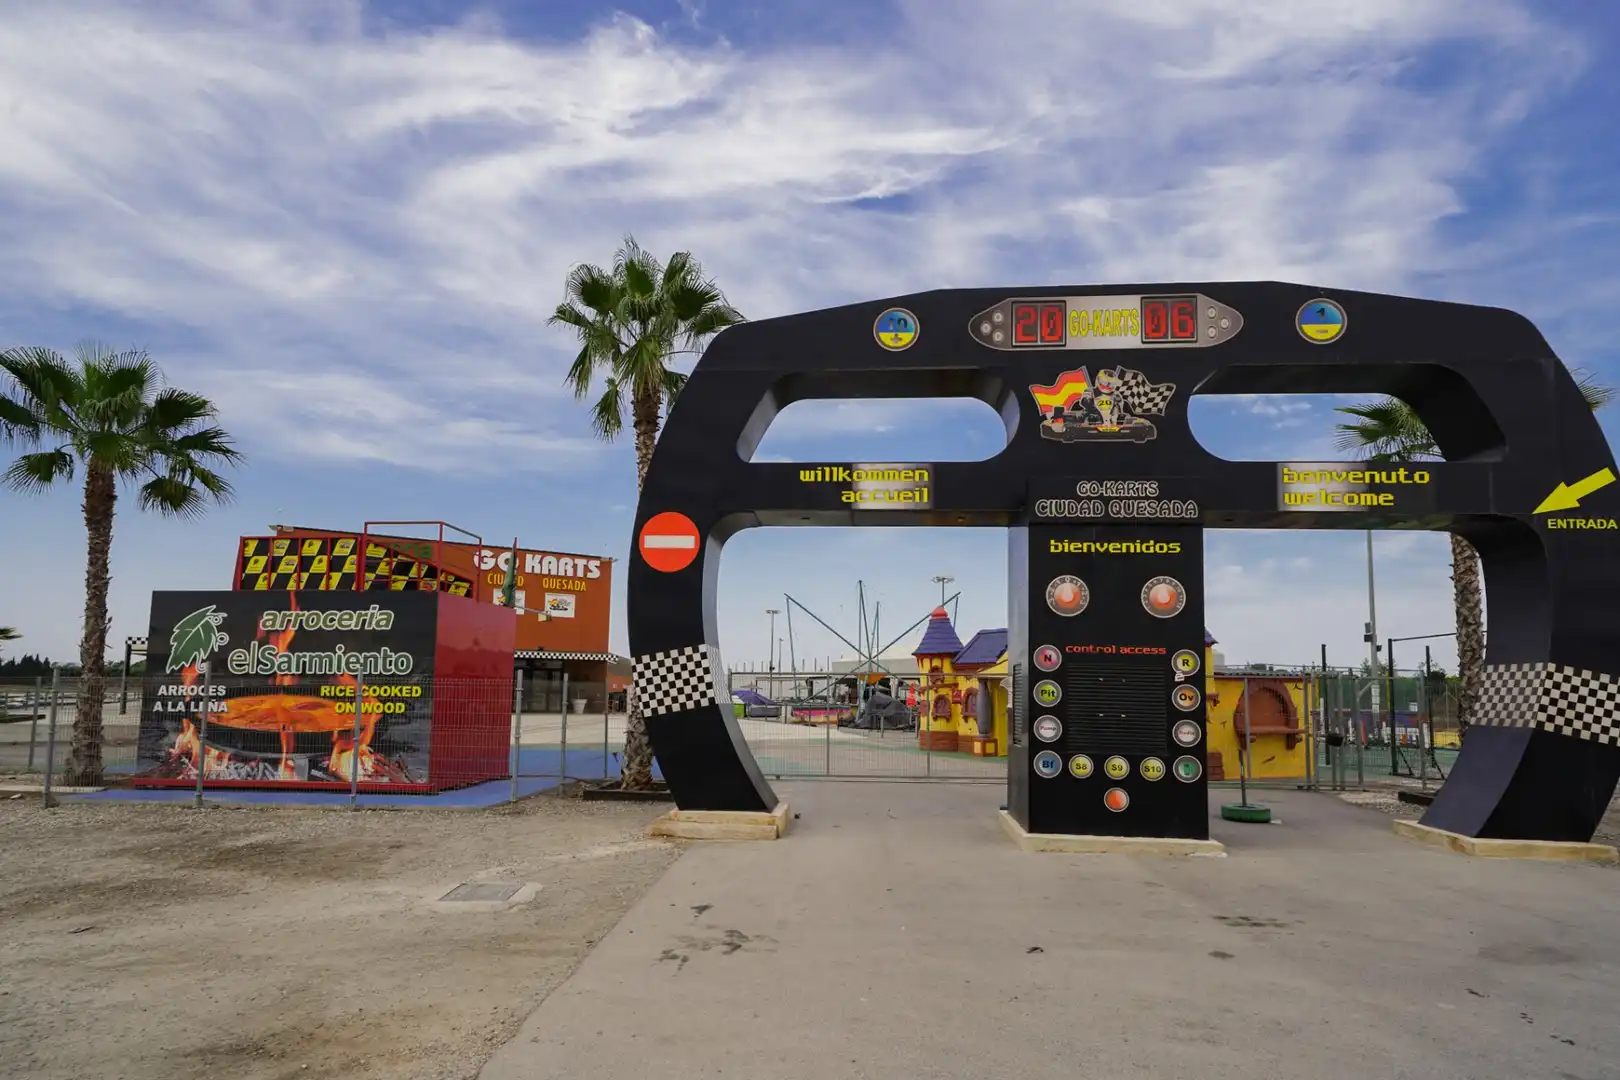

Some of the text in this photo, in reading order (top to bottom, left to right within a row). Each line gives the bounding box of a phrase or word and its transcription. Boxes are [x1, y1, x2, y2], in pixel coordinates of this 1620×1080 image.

[1015, 301, 1194, 343] 20 GO-KARTS 06
[800, 467, 929, 482] willkommen
[1282, 468, 1430, 484] benvenuto
[1076, 481, 1159, 497] GO-KARTS
[841, 488, 929, 503] accueil
[1283, 489, 1394, 506] welcome
[1035, 499, 1199, 518] CIUDAD QUESADA
[1547, 518, 1618, 529] ENTRADA
[1050, 540, 1181, 553] bienvenidos
[473, 549, 601, 579] GO KARTS
[487, 573, 587, 592] CIUD QUESADA
[260, 604, 394, 630] arroceria
[1066, 645, 1166, 655] control access
[228, 642, 413, 675] elSarmiento
[1043, 654, 1052, 662] N
[1182, 658, 1190, 667] R
[320, 685, 422, 697] RICE COOKED
[1040, 688, 1056, 697] Pit
[1179, 693, 1194, 701] Ov
[153, 701, 163, 712] A
[167, 701, 186, 712] LA
[335, 702, 405, 714] ON WOOD
[1042, 760, 1055, 769] Bf
[1111, 763, 1124, 771] S9
[1144, 765, 1162, 773] S10
